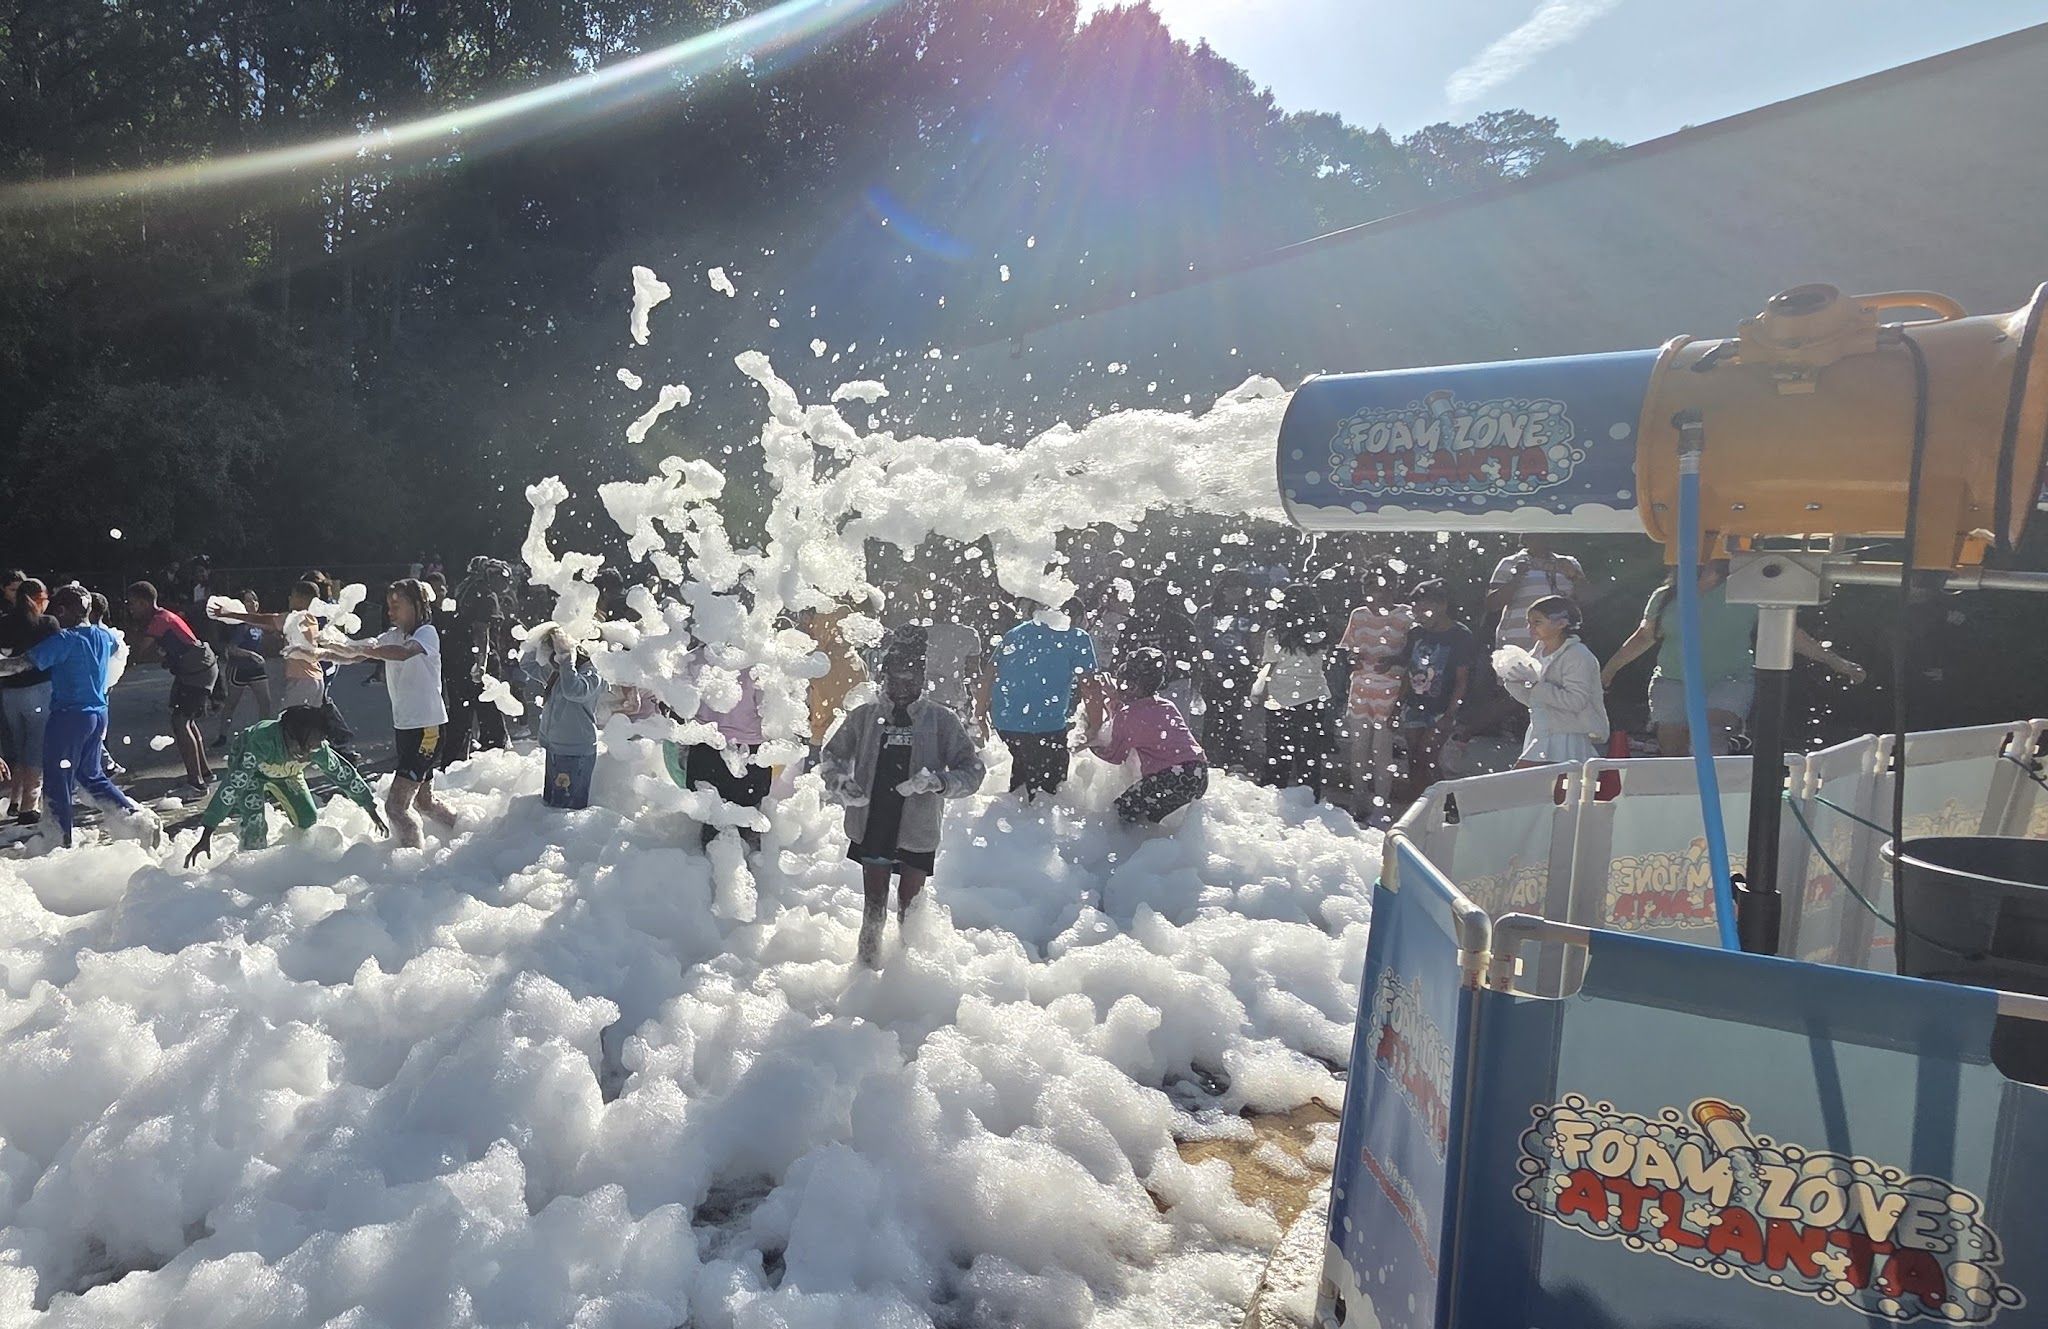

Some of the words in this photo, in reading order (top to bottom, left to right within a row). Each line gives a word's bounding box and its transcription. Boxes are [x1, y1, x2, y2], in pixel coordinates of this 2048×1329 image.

[1349, 419, 1441, 453] FOAM
[1450, 412, 1549, 450] ZONE
[1553, 1119, 1734, 1207] FOAM
[1760, 1166, 1954, 1253] ZONE
[1555, 1169, 1948, 1309] ATLANTA
